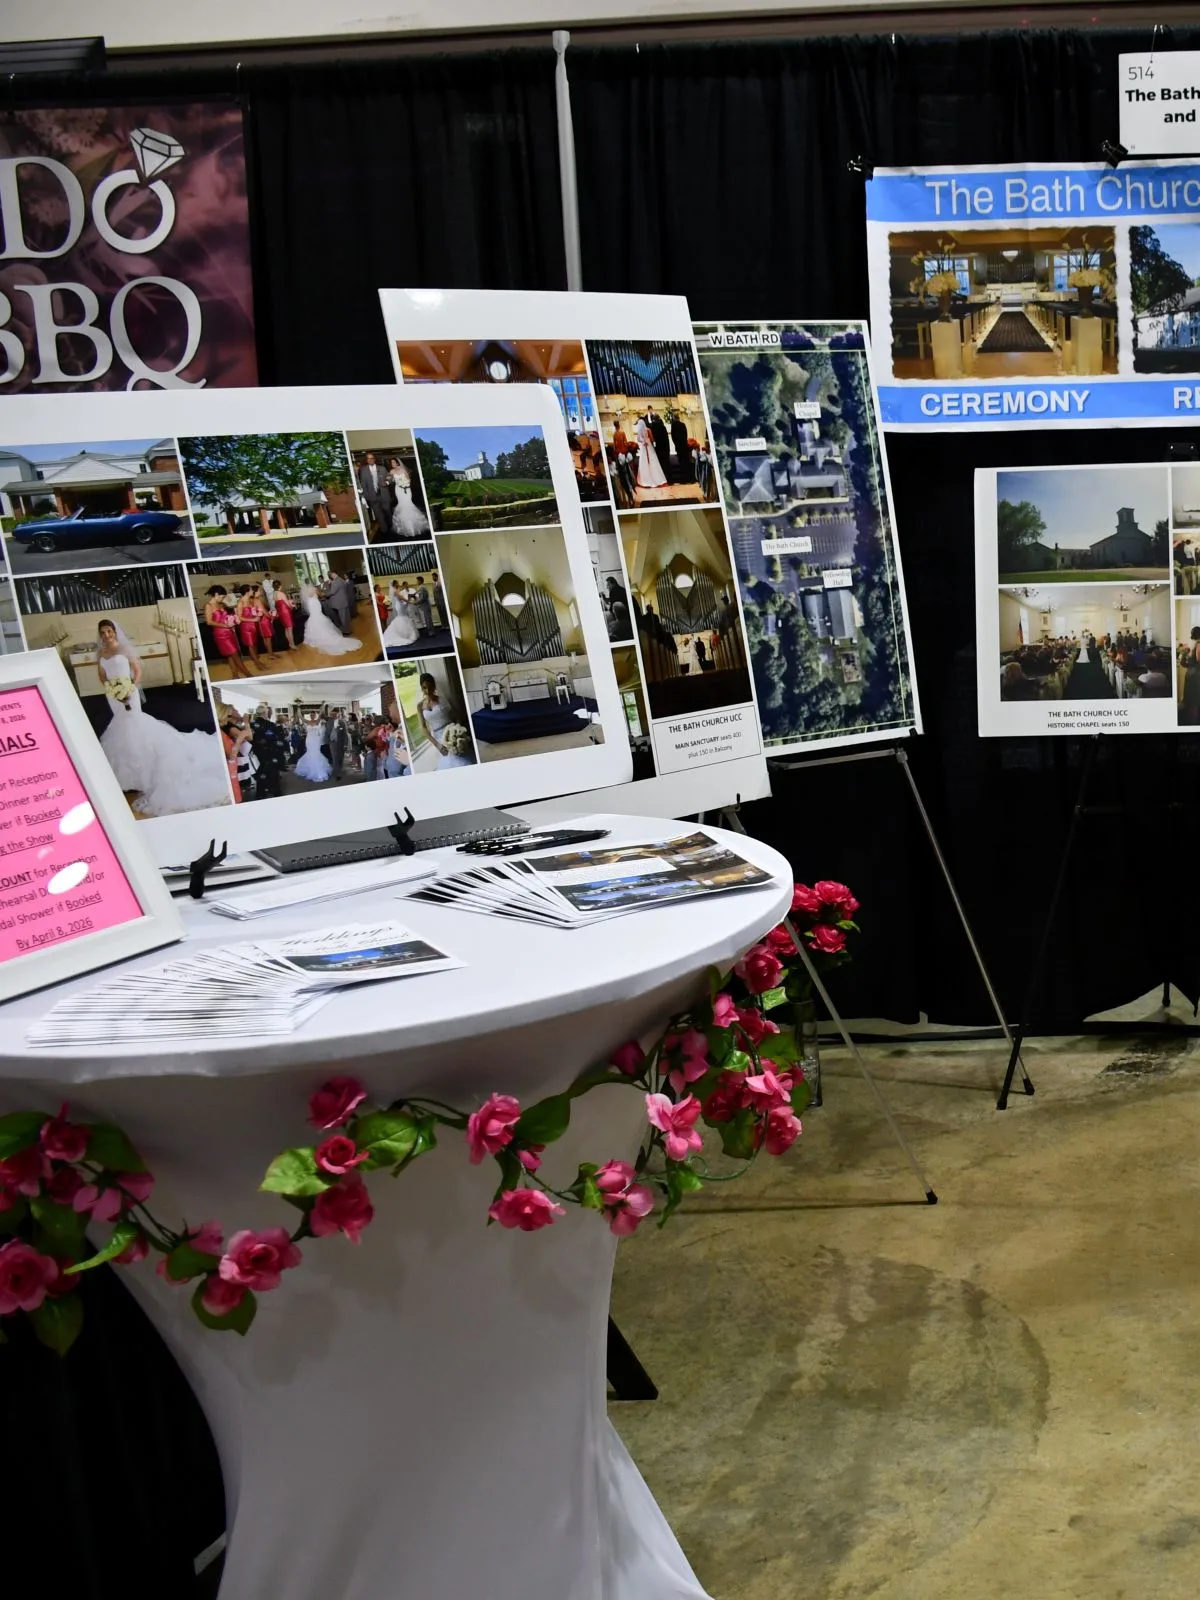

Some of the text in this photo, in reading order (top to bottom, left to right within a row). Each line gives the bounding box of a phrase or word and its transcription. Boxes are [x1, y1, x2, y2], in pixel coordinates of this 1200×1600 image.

[1128, 66, 1154, 80] 514
[1125, 89, 1156, 102] The
[1160, 86, 1200, 100] Bath
[1163, 109, 1196, 123] and
[925, 179, 994, 215] The
[1005, 176, 1085, 213] Bath
[0, 275, 207, 391] BQ
[710, 333, 779, 345] W BATH RD
[919, 389, 1090, 417] CEREMONY
[789, 540, 809, 549] Church
[1114, 709, 1128, 717] UCC
[668, 712, 743, 734] THE BATH CHURCH UCC
[1047, 721, 1075, 729] HISTORIC
[0, 732, 37, 754] IALS
[675, 741, 690, 750] MAIN
[690, 736, 719, 747] SANCTUARY
[9, 771, 58, 787] Reception
[24, 807, 62, 824] Booked
[25, 834, 53, 847] Show
[0, 871, 31, 889] OUNT
[33, 868, 48, 879] for
[16, 907, 54, 925] Shower
[65, 891, 102, 910] Booked
[32, 925, 55, 944] April
[68, 917, 93, 932] 2026
